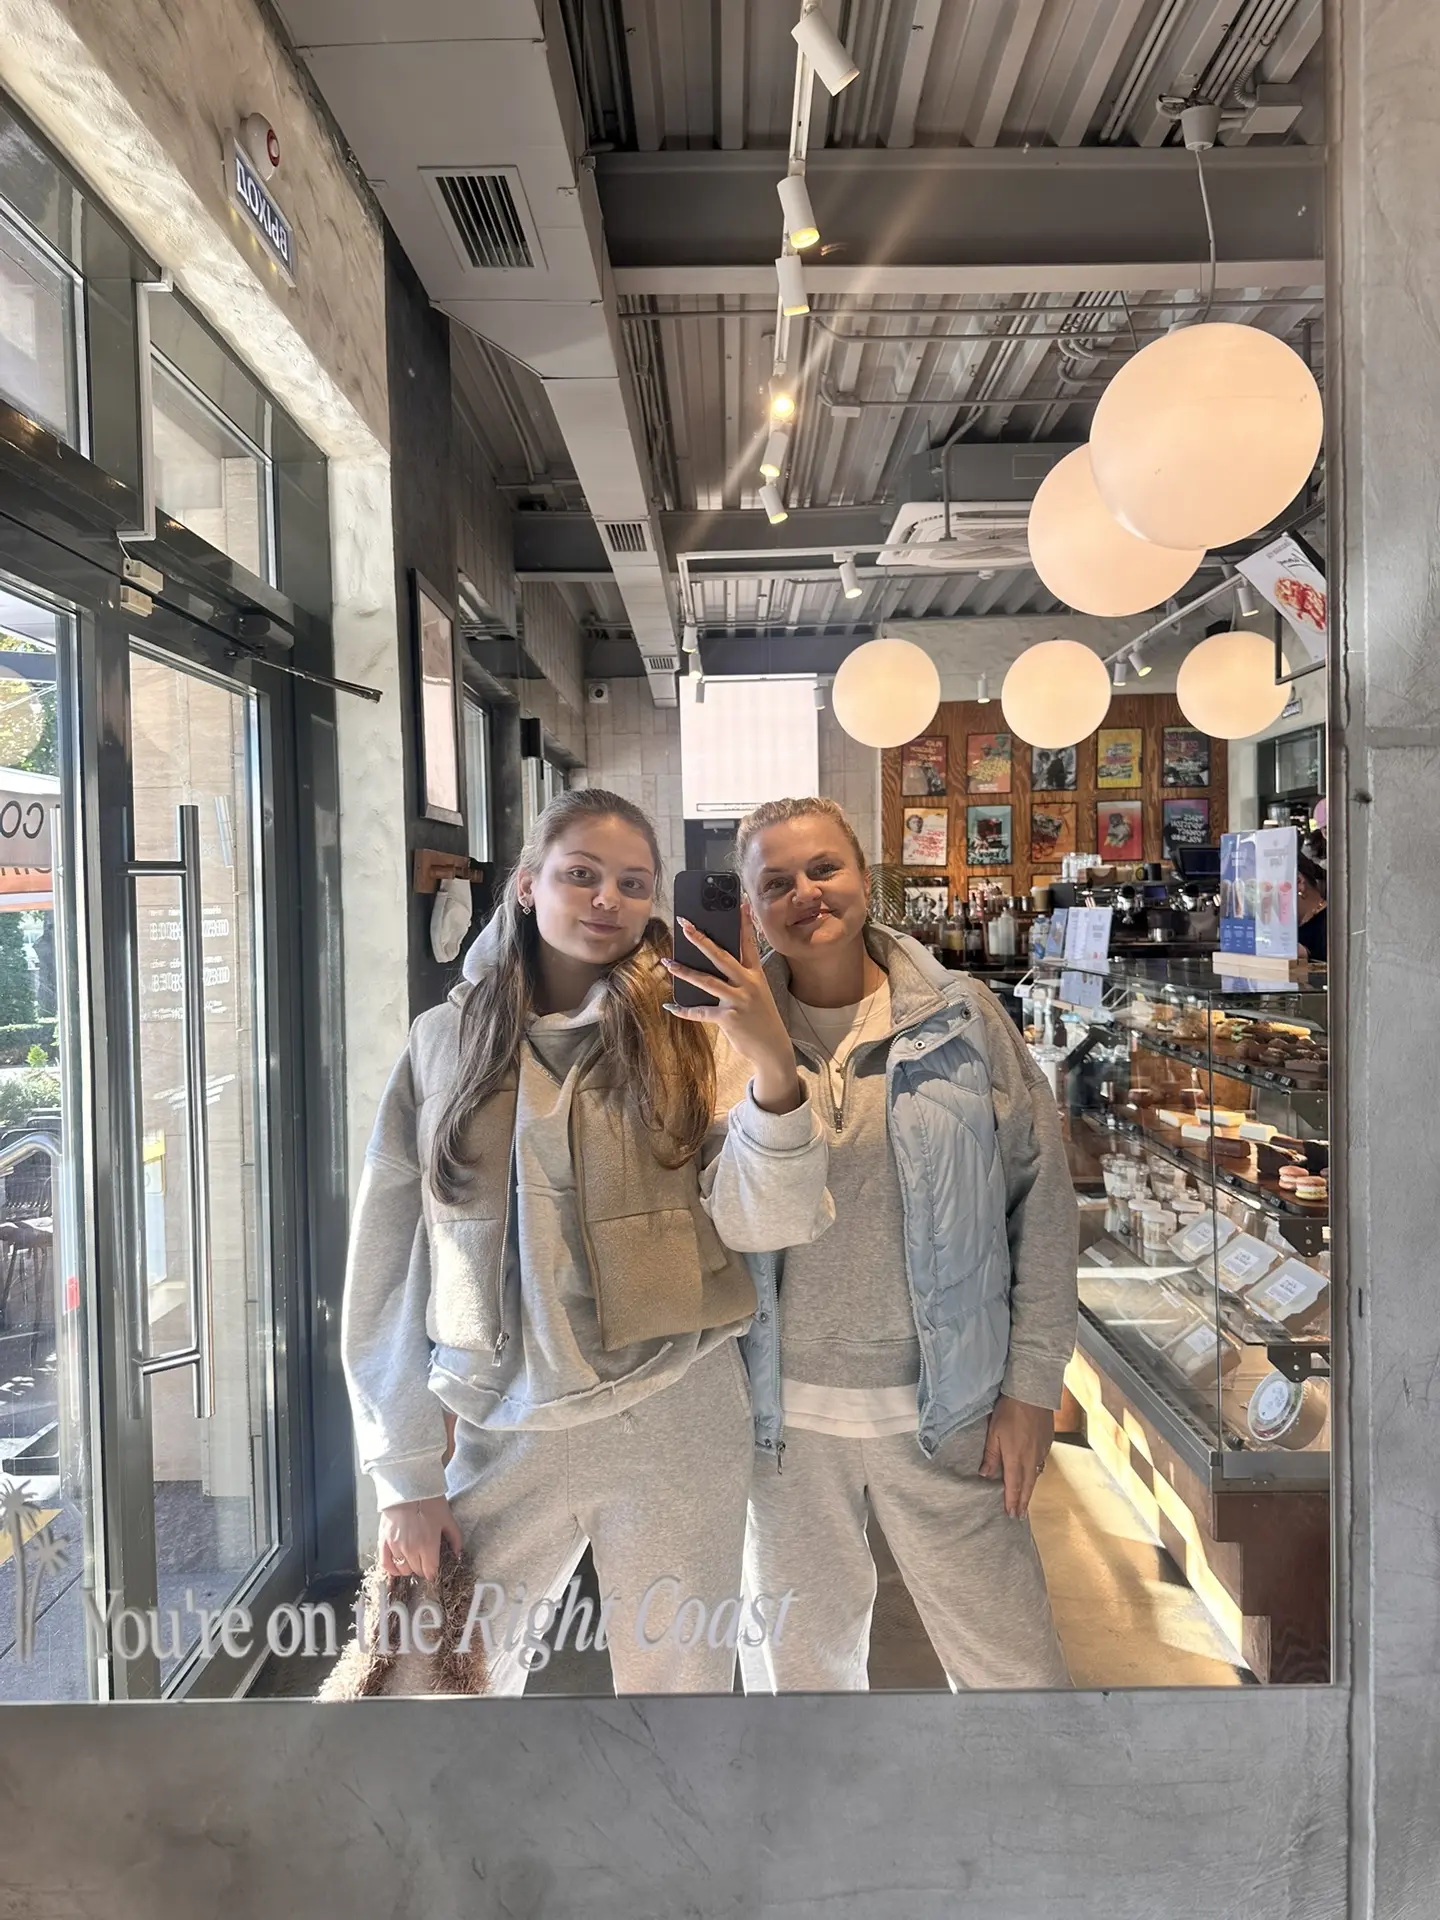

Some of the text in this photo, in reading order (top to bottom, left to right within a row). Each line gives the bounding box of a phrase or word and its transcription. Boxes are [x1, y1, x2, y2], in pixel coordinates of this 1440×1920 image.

[83, 1575, 800, 1671] You're on the Right Coast
